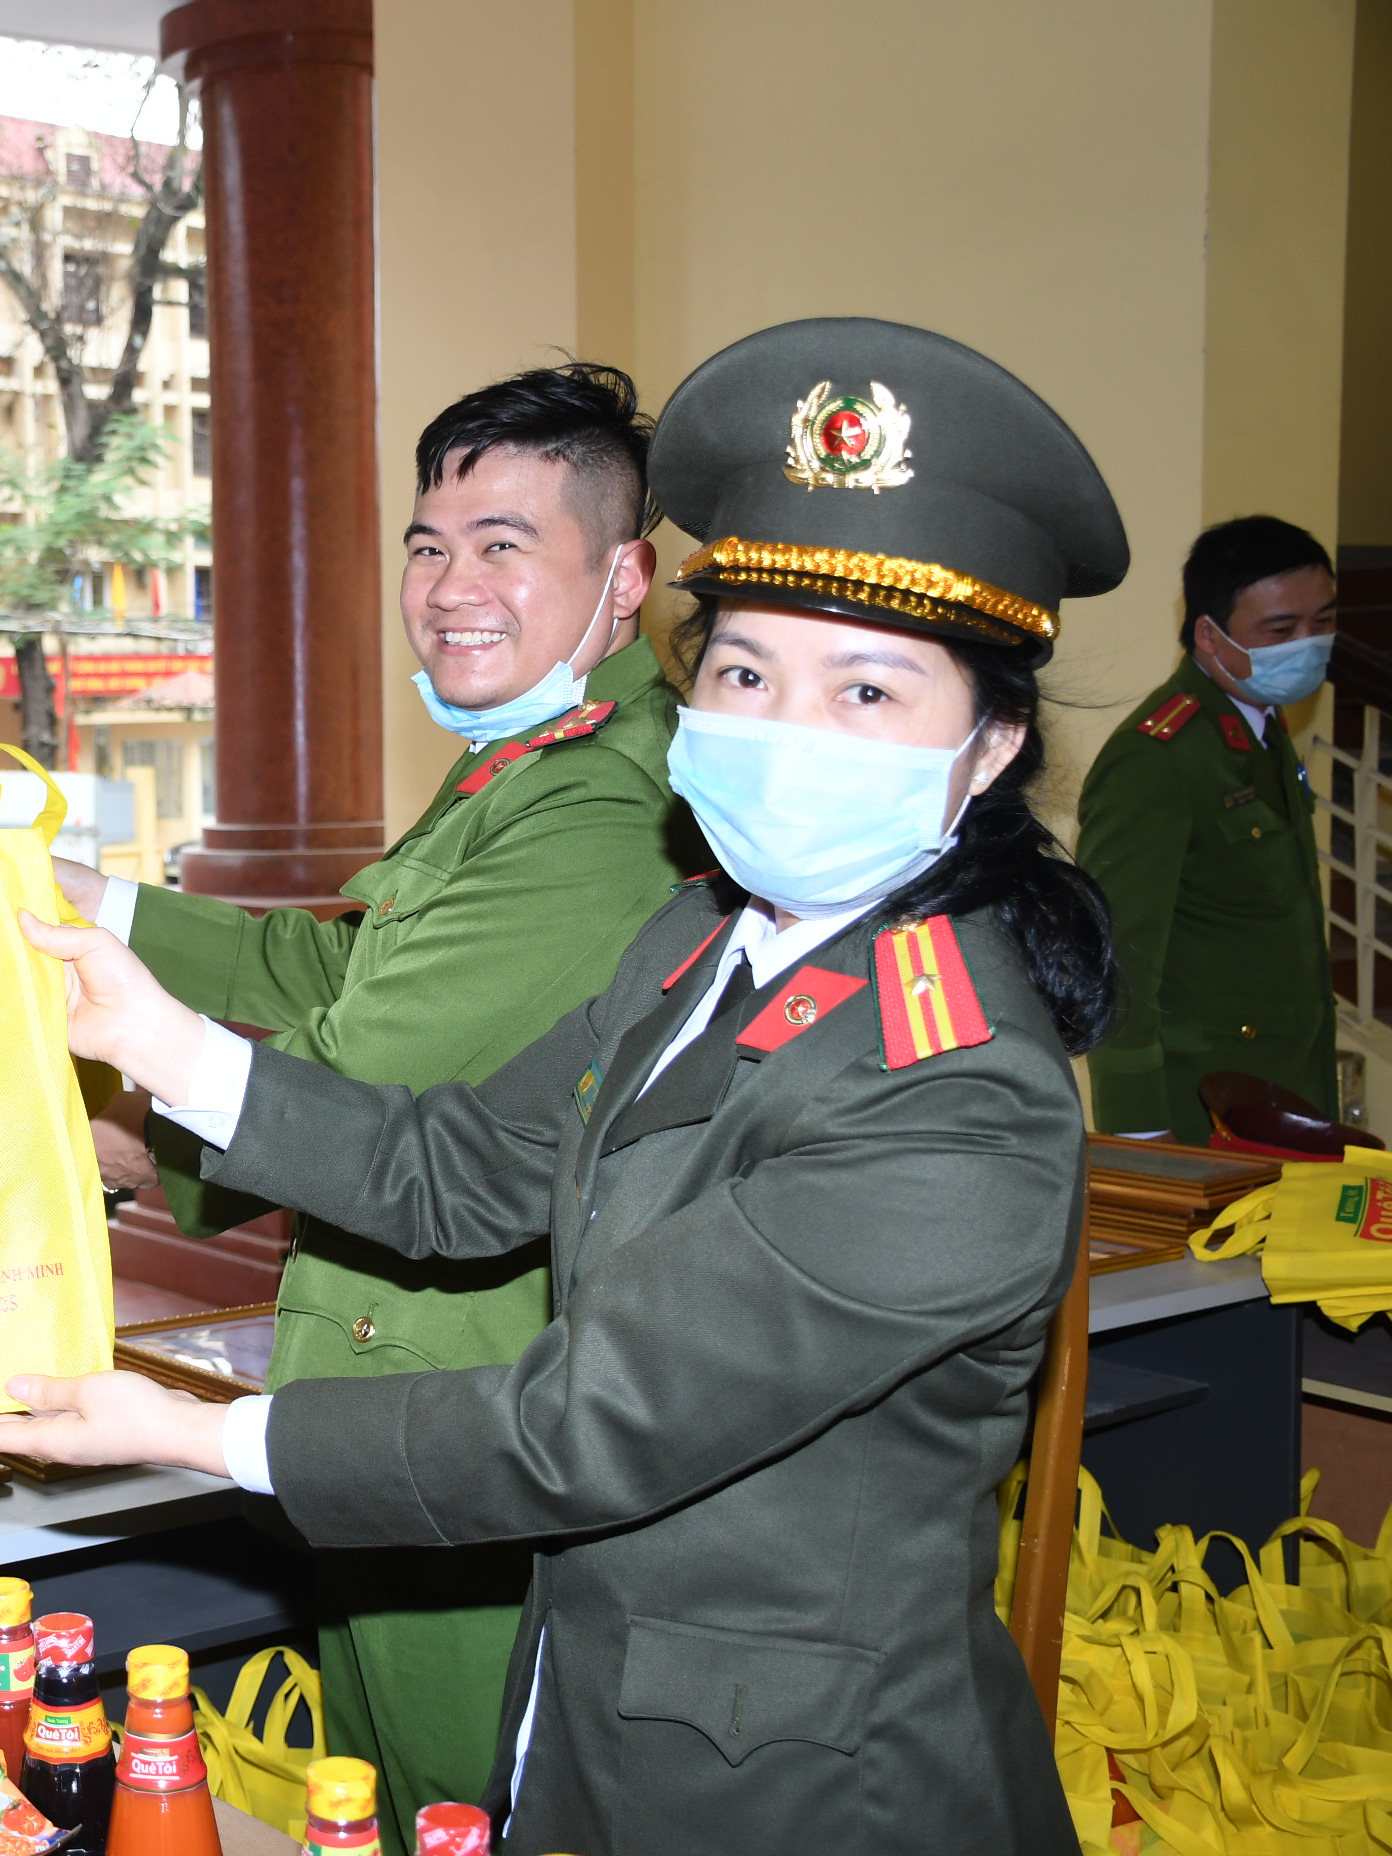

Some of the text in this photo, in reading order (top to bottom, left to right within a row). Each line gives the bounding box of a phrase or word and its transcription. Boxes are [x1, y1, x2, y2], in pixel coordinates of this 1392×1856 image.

[27, 1262, 64, 1281] MINH
[38, 1725, 78, 1740] QuêTôi
[132, 1758, 176, 1775] QuêTôi
